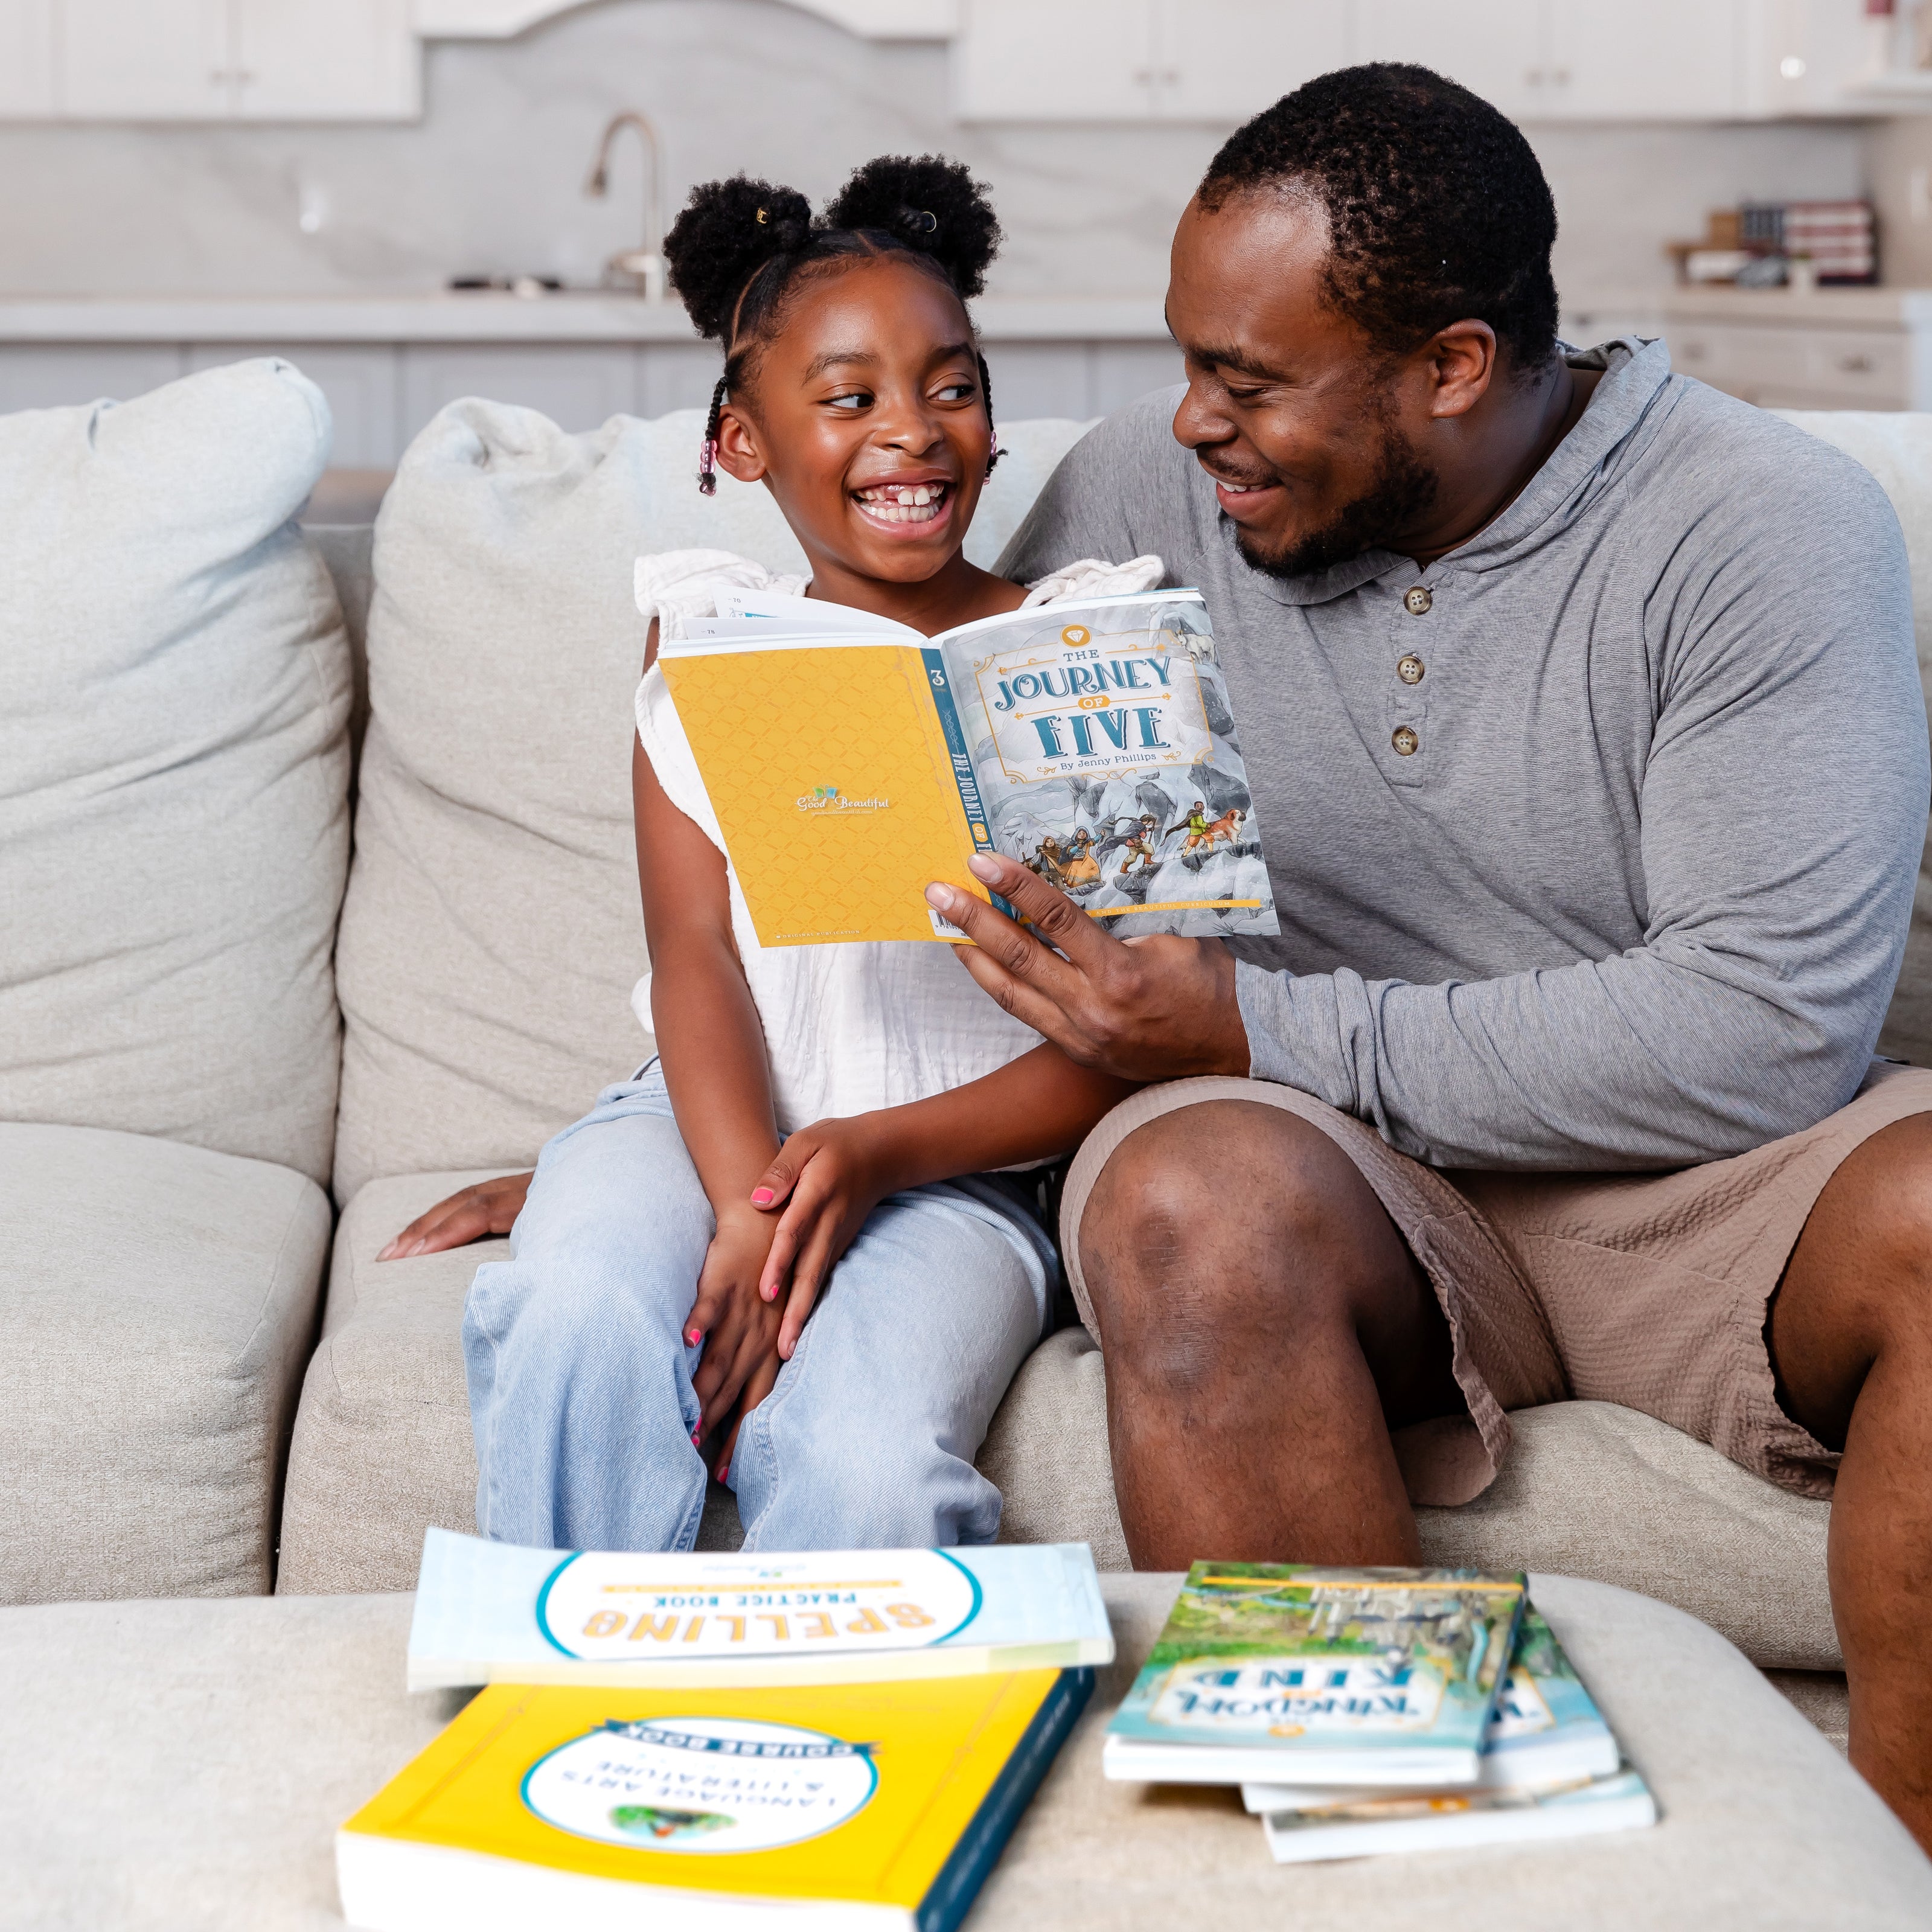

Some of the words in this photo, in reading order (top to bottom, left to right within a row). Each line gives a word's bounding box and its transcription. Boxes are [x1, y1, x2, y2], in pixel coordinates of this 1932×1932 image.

[1063, 650, 1099, 662] THE
[930, 670, 945, 686] 3
[994, 656, 1171, 711] JOURNEY
[1083, 697, 1104, 708] OF
[1031, 707, 1171, 759] FIVE
[952, 753, 971, 772] THE
[1060, 763, 1073, 771] By
[1078, 758, 1111, 768] Jenny
[1115, 753, 1157, 764] Phillips
[795, 797, 827, 811] Good
[834, 796, 889, 810] Beautiful
[958, 775, 985, 822] JOURNEY
[974, 826, 985, 839] OF
[654, 1595, 720, 1608] BOOK
[736, 1592, 857, 1607] PRACTICE
[582, 1602, 936, 1642] SPELLING
[1193, 1668, 1414, 1688] KIND
[621, 1723, 708, 1752] BOOK
[724, 1740, 854, 1758] COURSE
[560, 1770, 642, 1792] ARTS
[598, 1760, 789, 1792] LITERATURE
[657, 1785, 837, 1807] LANGUAGE
